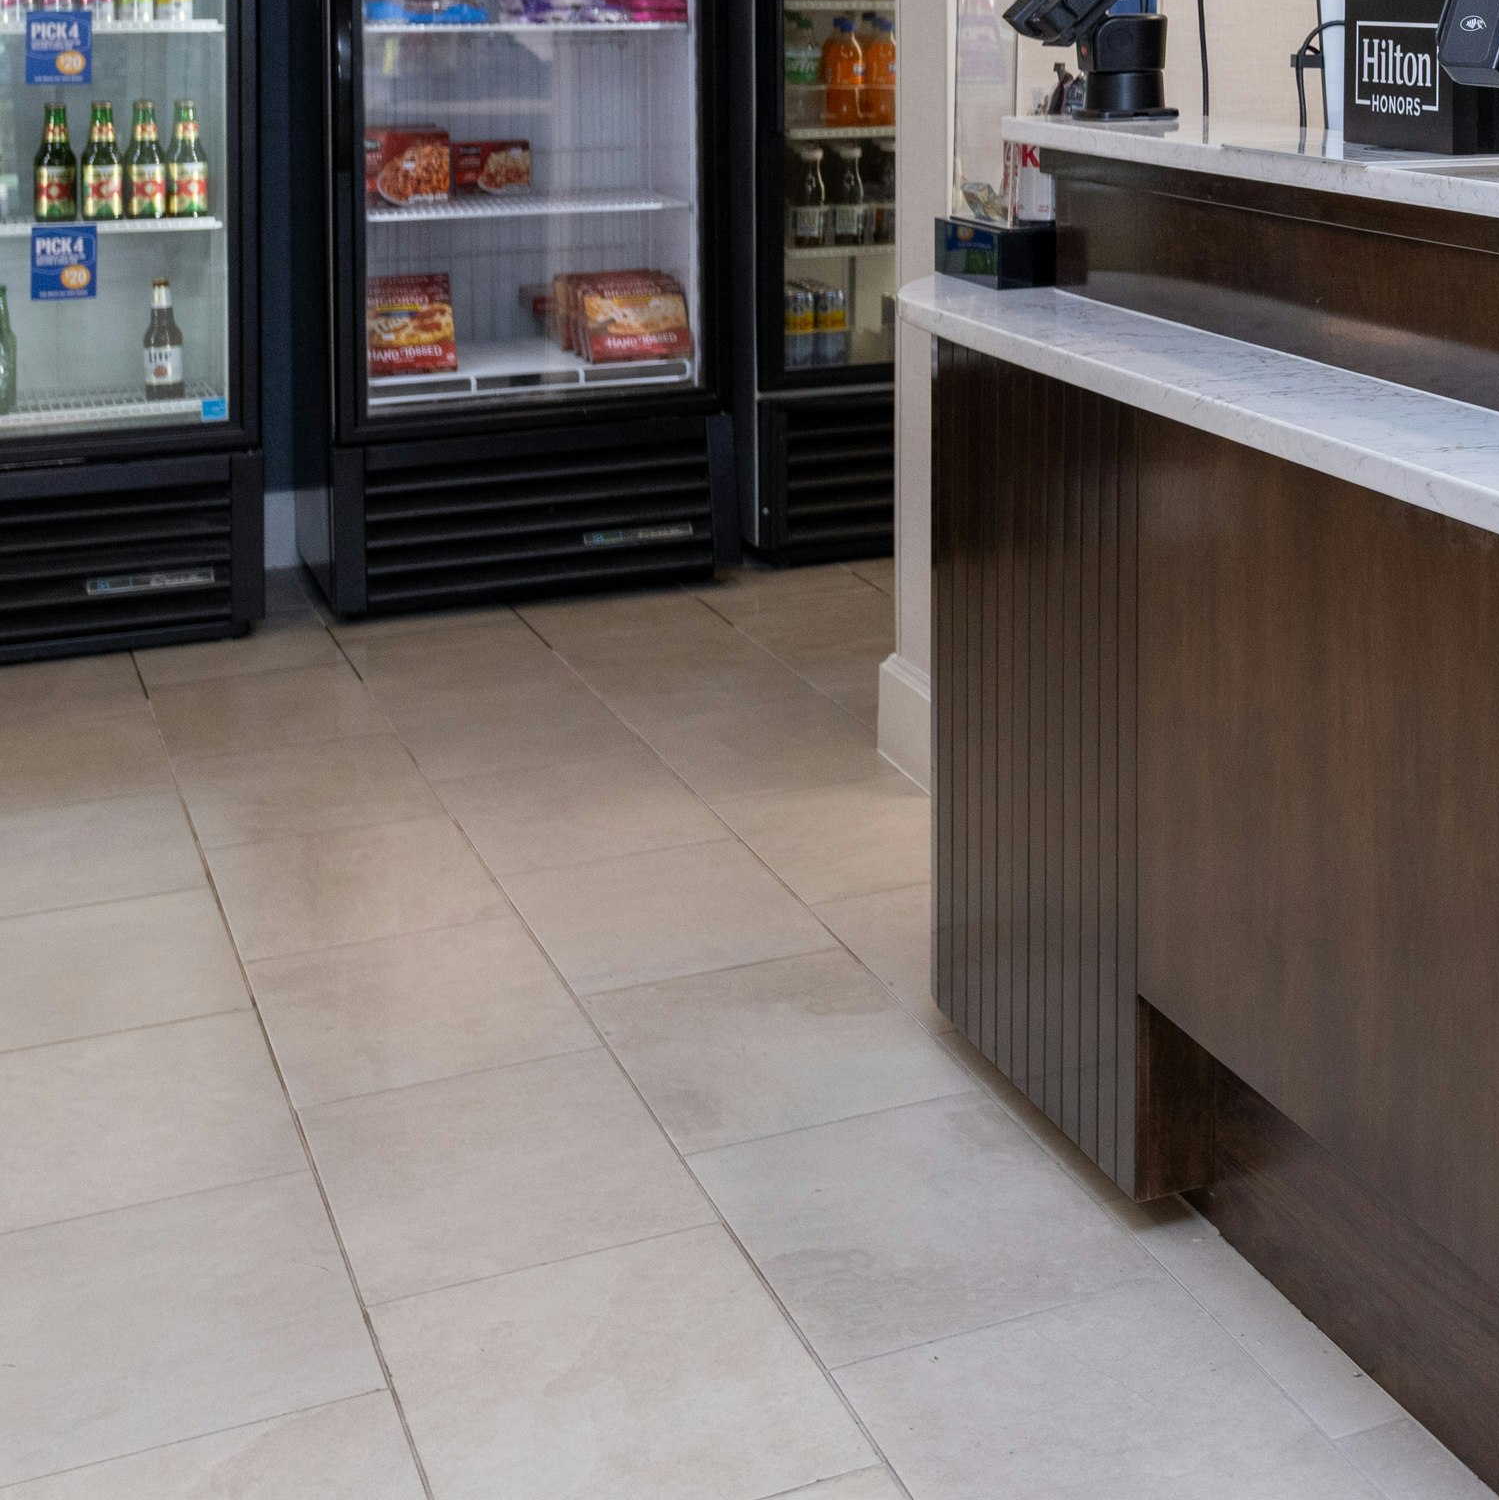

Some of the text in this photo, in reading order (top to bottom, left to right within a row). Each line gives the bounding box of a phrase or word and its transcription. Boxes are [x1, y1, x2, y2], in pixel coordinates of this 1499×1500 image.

[31, 21, 79, 41] PICK 4
[1362, 38, 1432, 87] Hilton
[1371, 94, 1421, 117] HONORS
[36, 235, 85, 255] PICK 4
[367, 347, 400, 363] HAND
